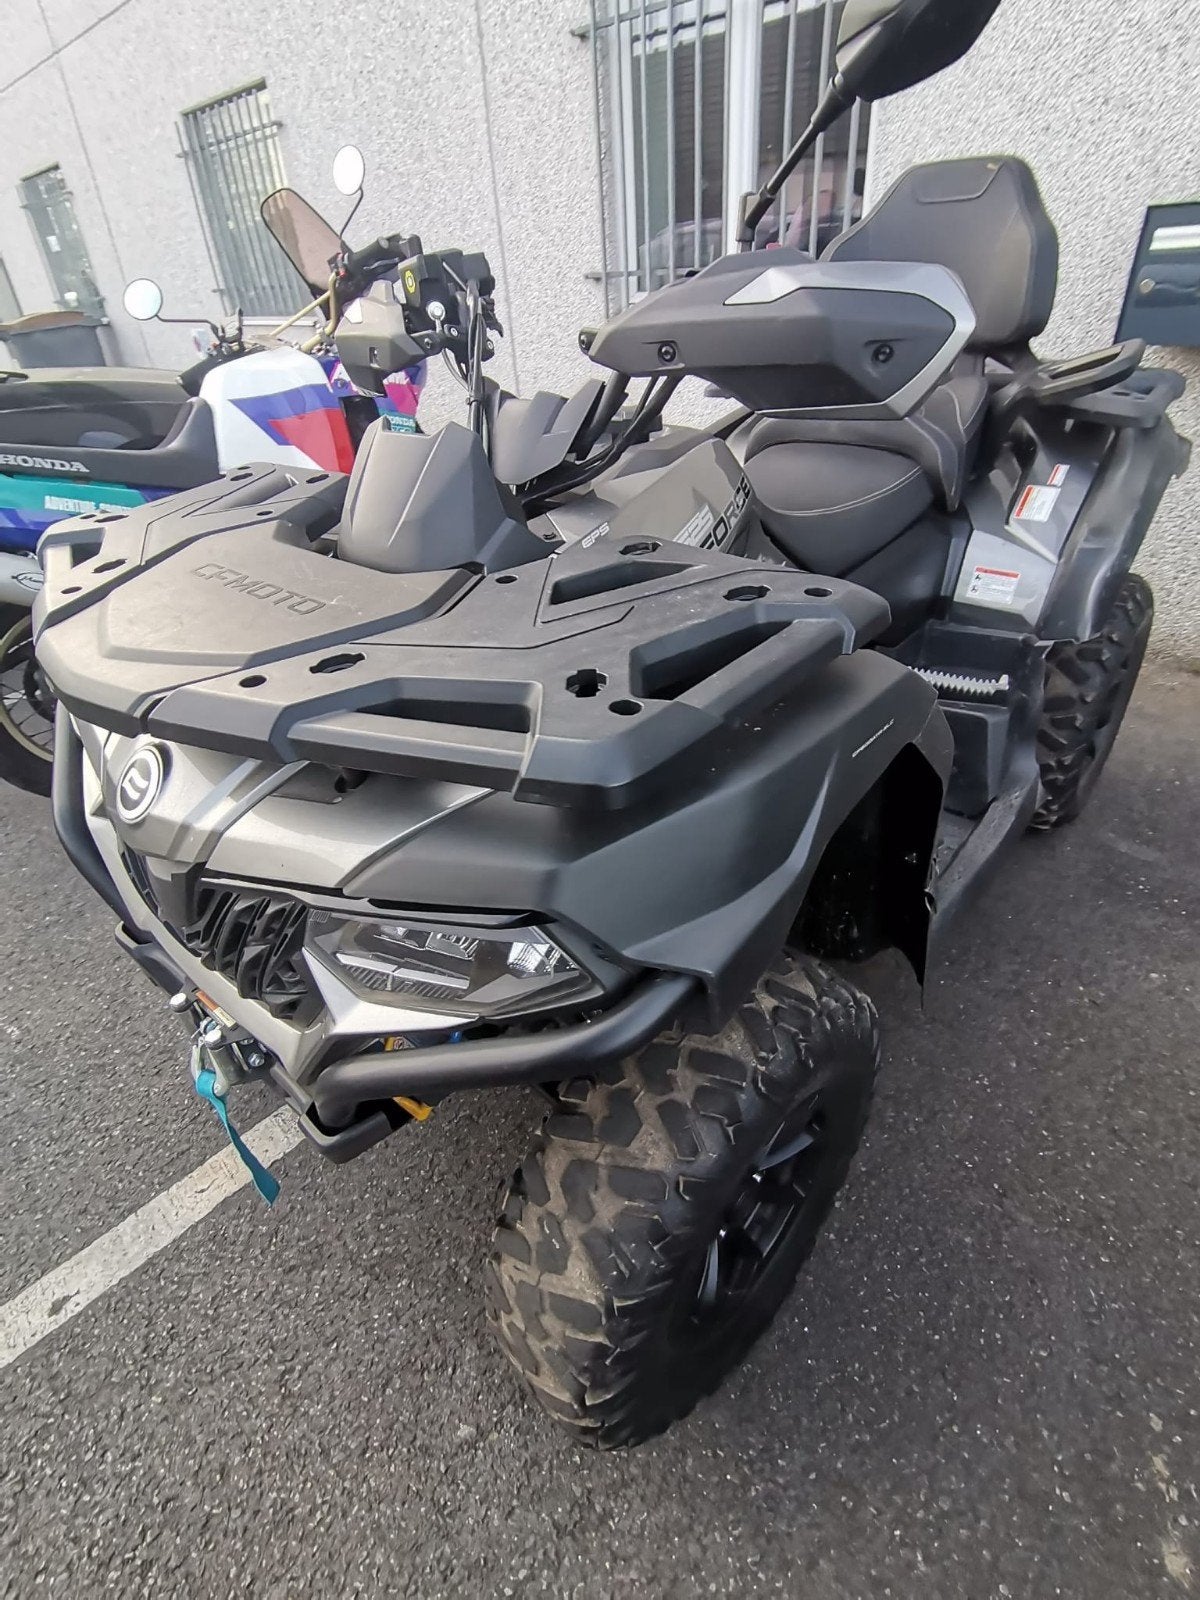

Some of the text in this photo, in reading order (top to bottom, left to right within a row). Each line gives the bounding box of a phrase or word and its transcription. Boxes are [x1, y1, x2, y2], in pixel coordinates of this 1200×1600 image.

[0, 454, 90, 473] HONDA
[581, 522, 610, 549] EPS
[190, 562, 327, 615] CFMOTO
